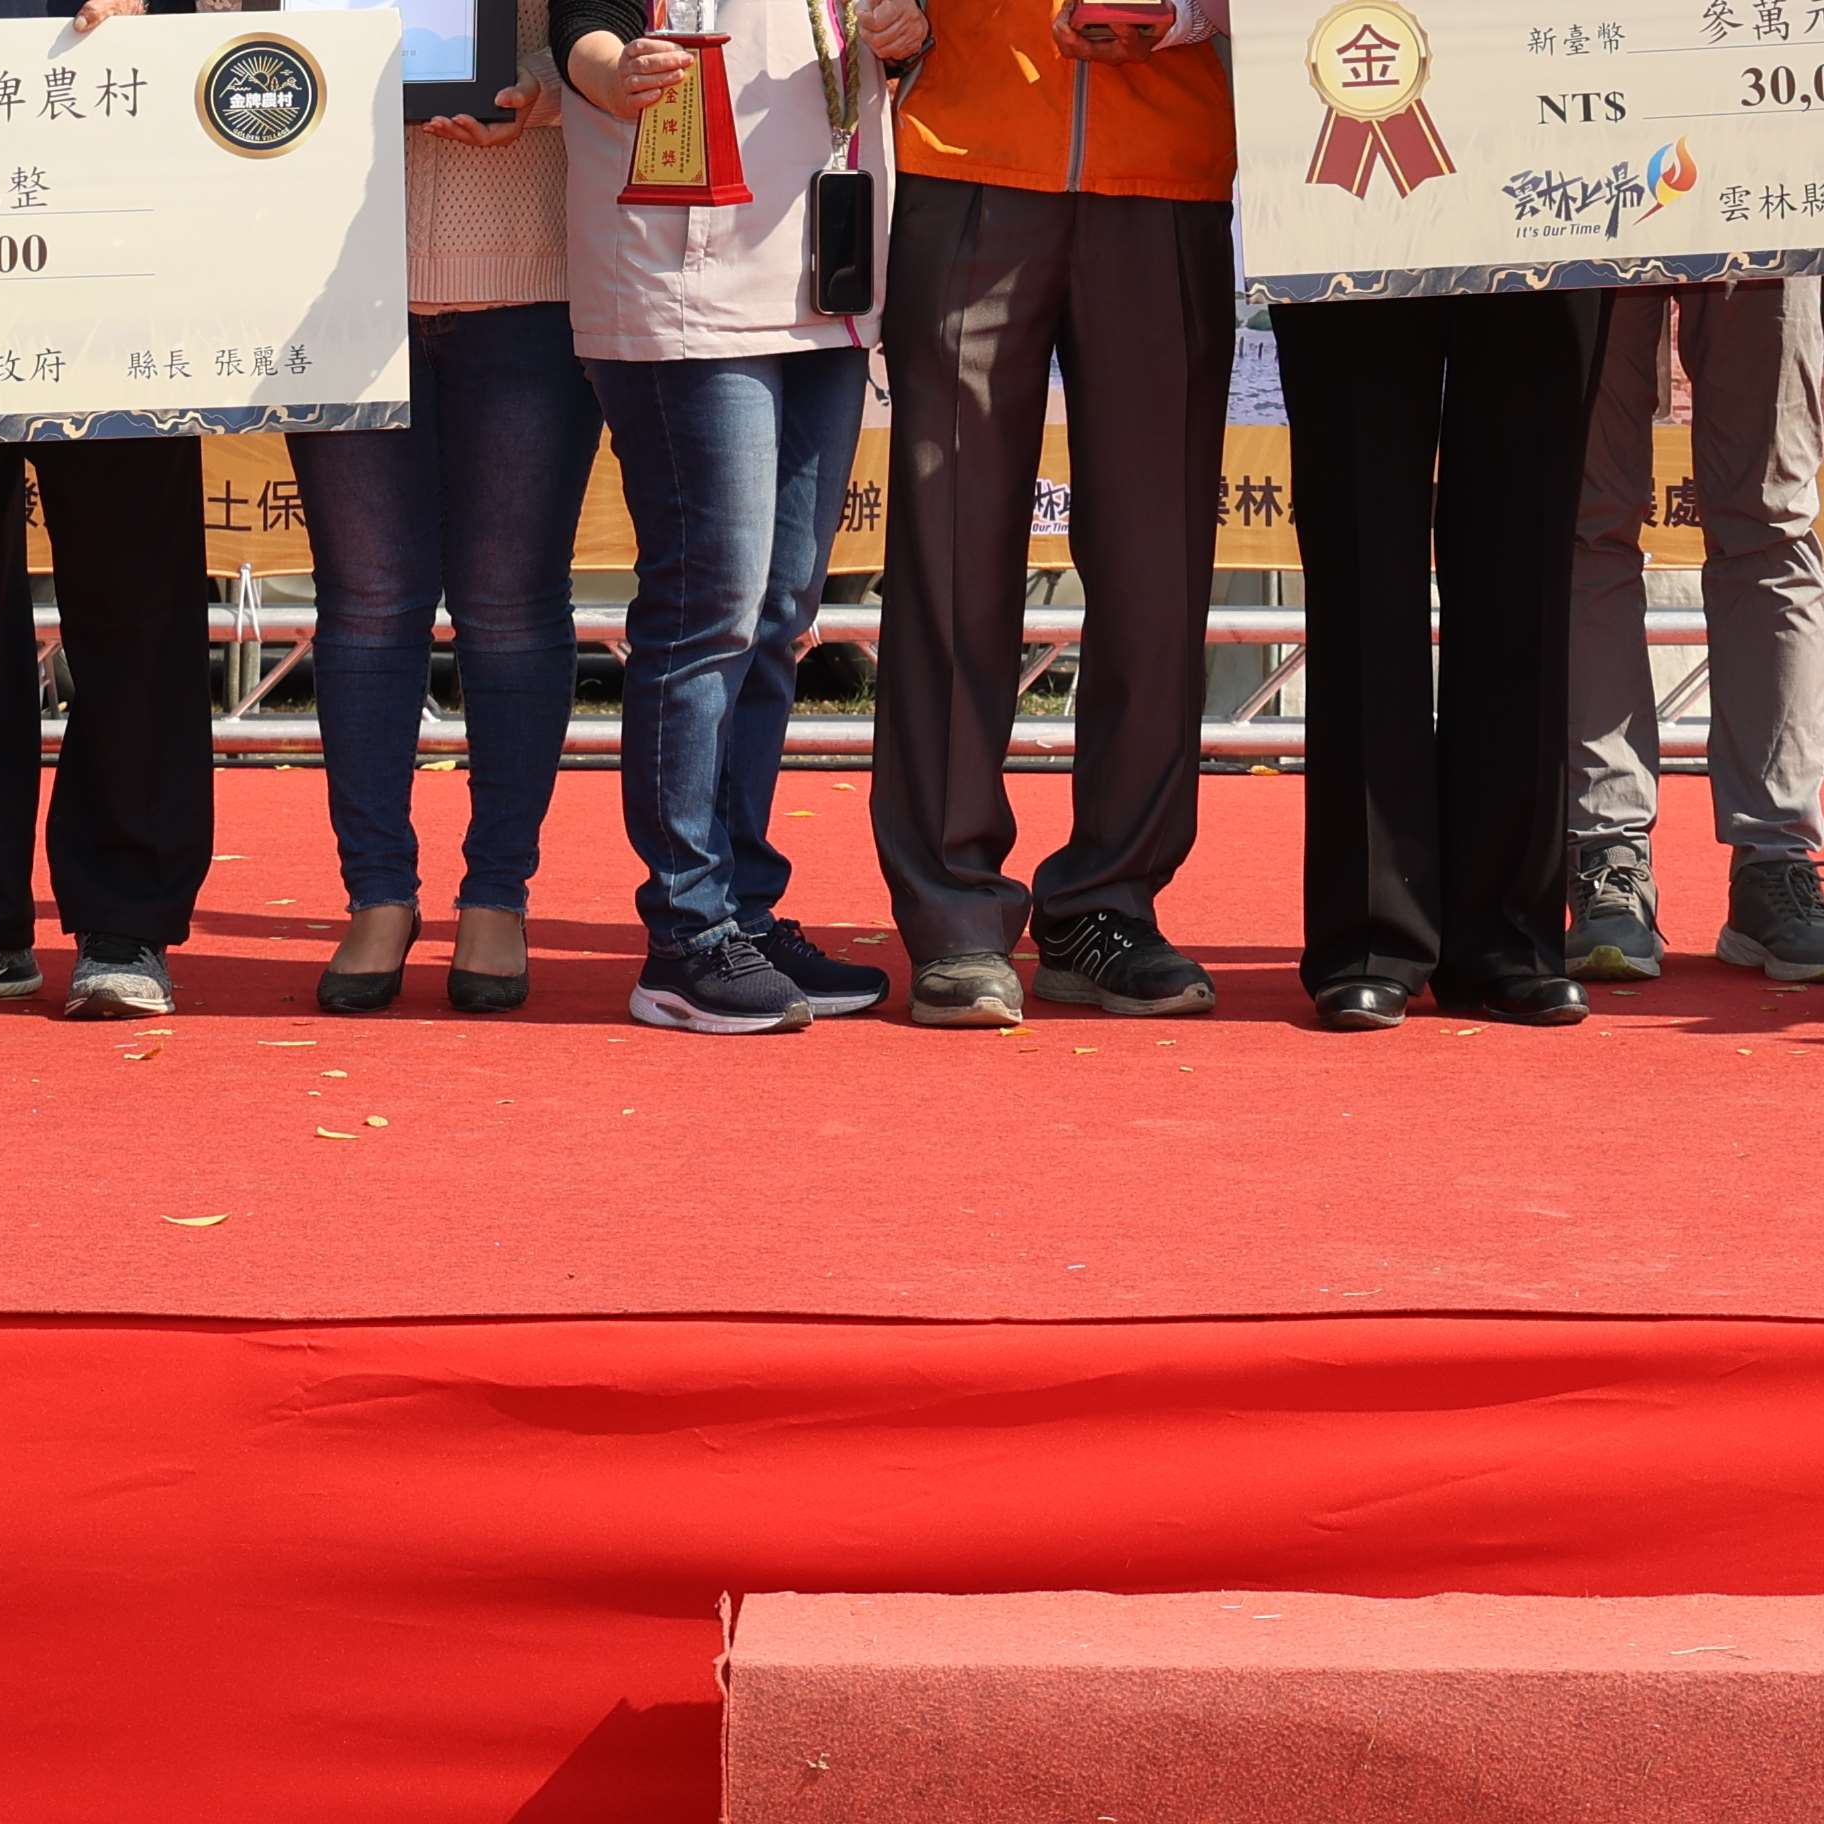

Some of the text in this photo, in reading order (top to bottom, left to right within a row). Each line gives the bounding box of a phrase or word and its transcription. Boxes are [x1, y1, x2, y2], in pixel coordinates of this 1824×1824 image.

[1335, 24, 1403, 88] 金
[1527, 21, 1626, 57] 新臺幣
[229, 91, 293, 109] 金牌農村
[1537, 91, 1627, 126] NT$
[661, 88, 678, 168] 金牌獎
[1515, 222, 1601, 239] It's Our Time
[127, 348, 193, 380] 縣長
[214, 344, 314, 378] 張麗善
